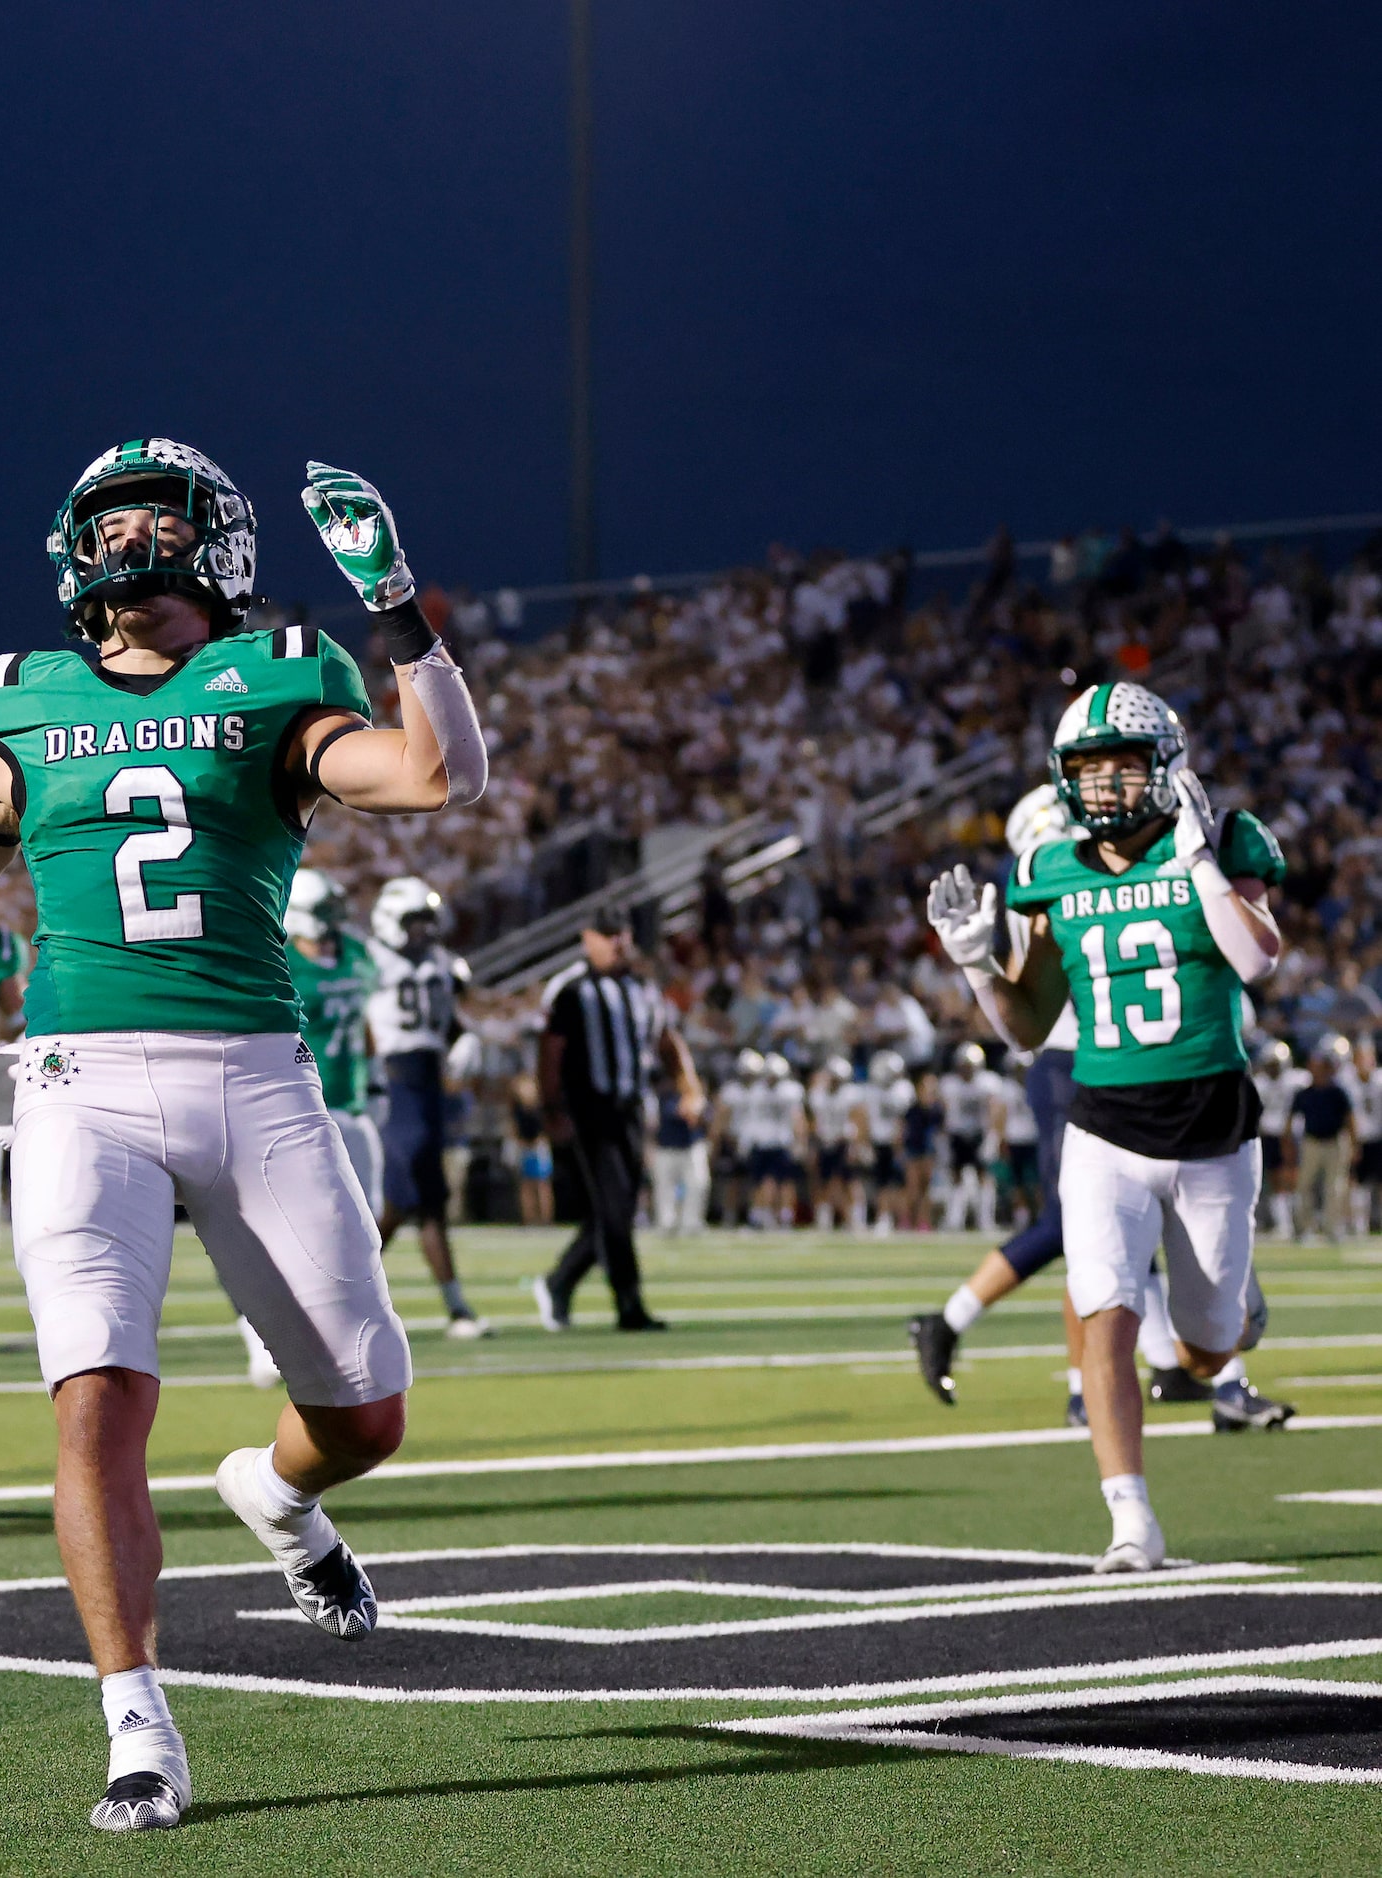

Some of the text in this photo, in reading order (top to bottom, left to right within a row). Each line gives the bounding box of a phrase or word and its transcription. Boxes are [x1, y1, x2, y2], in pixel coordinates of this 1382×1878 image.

[204, 680, 249, 694] adidas
[44, 714, 244, 763] DRAGONS
[103, 764, 204, 945] 2
[1061, 879, 1191, 920] DRAGONS
[1080, 919, 1182, 1048] 13
[118, 1717, 150, 1732] adidas
